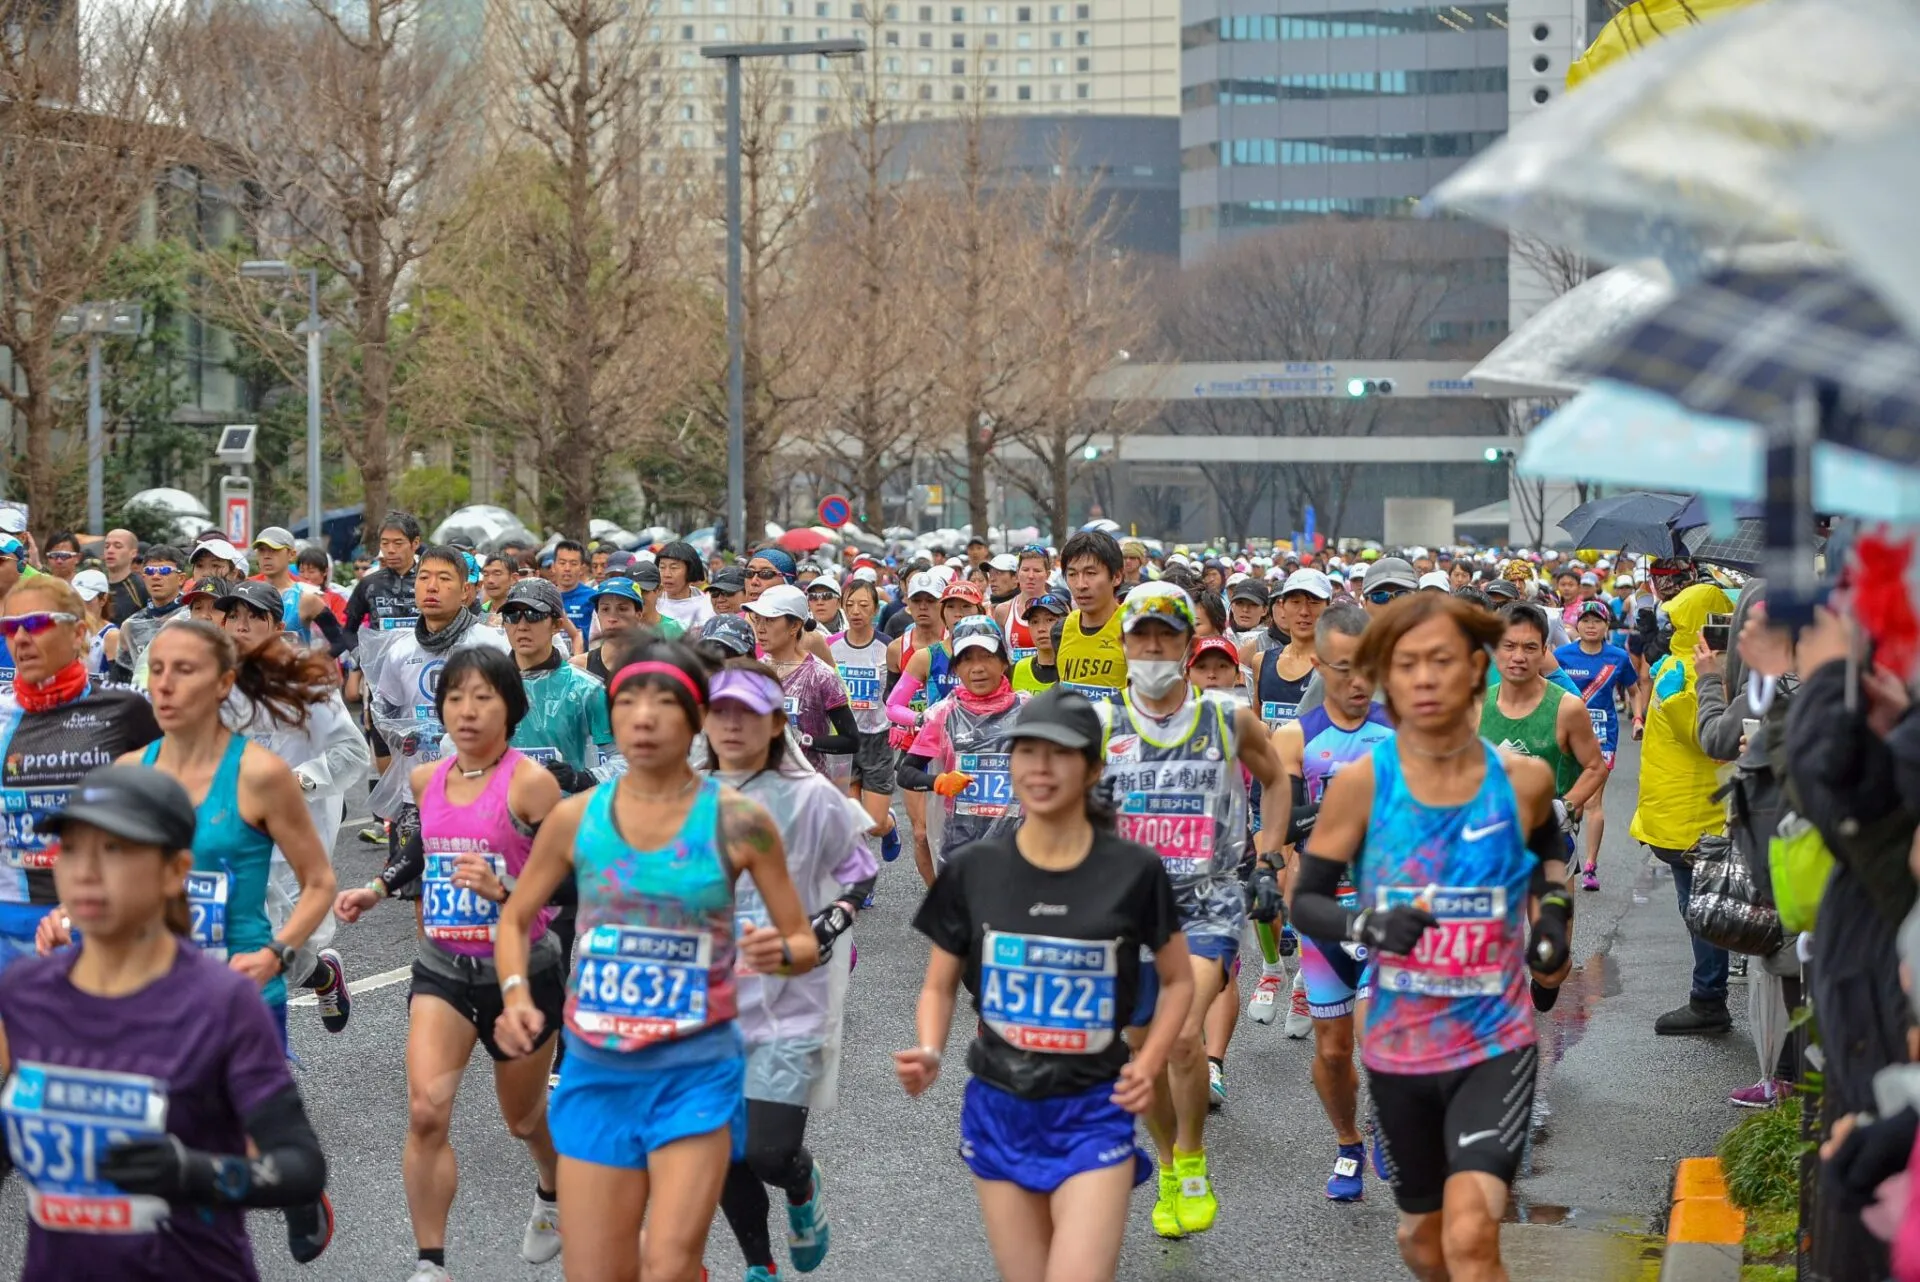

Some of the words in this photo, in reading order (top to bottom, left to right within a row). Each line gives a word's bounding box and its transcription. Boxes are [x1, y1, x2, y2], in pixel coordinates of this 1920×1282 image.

[1063, 658, 1113, 681] NISSO
[845, 681, 870, 697] 011
[23, 747, 110, 773] protrain
[963, 774, 1013, 798] 512
[1116, 767, 1218, 792] 新国立劇場
[1149, 798, 1201, 811] 東京メトロ
[578, 960, 688, 1009] A8637
[983, 969, 1095, 1020] A5122
